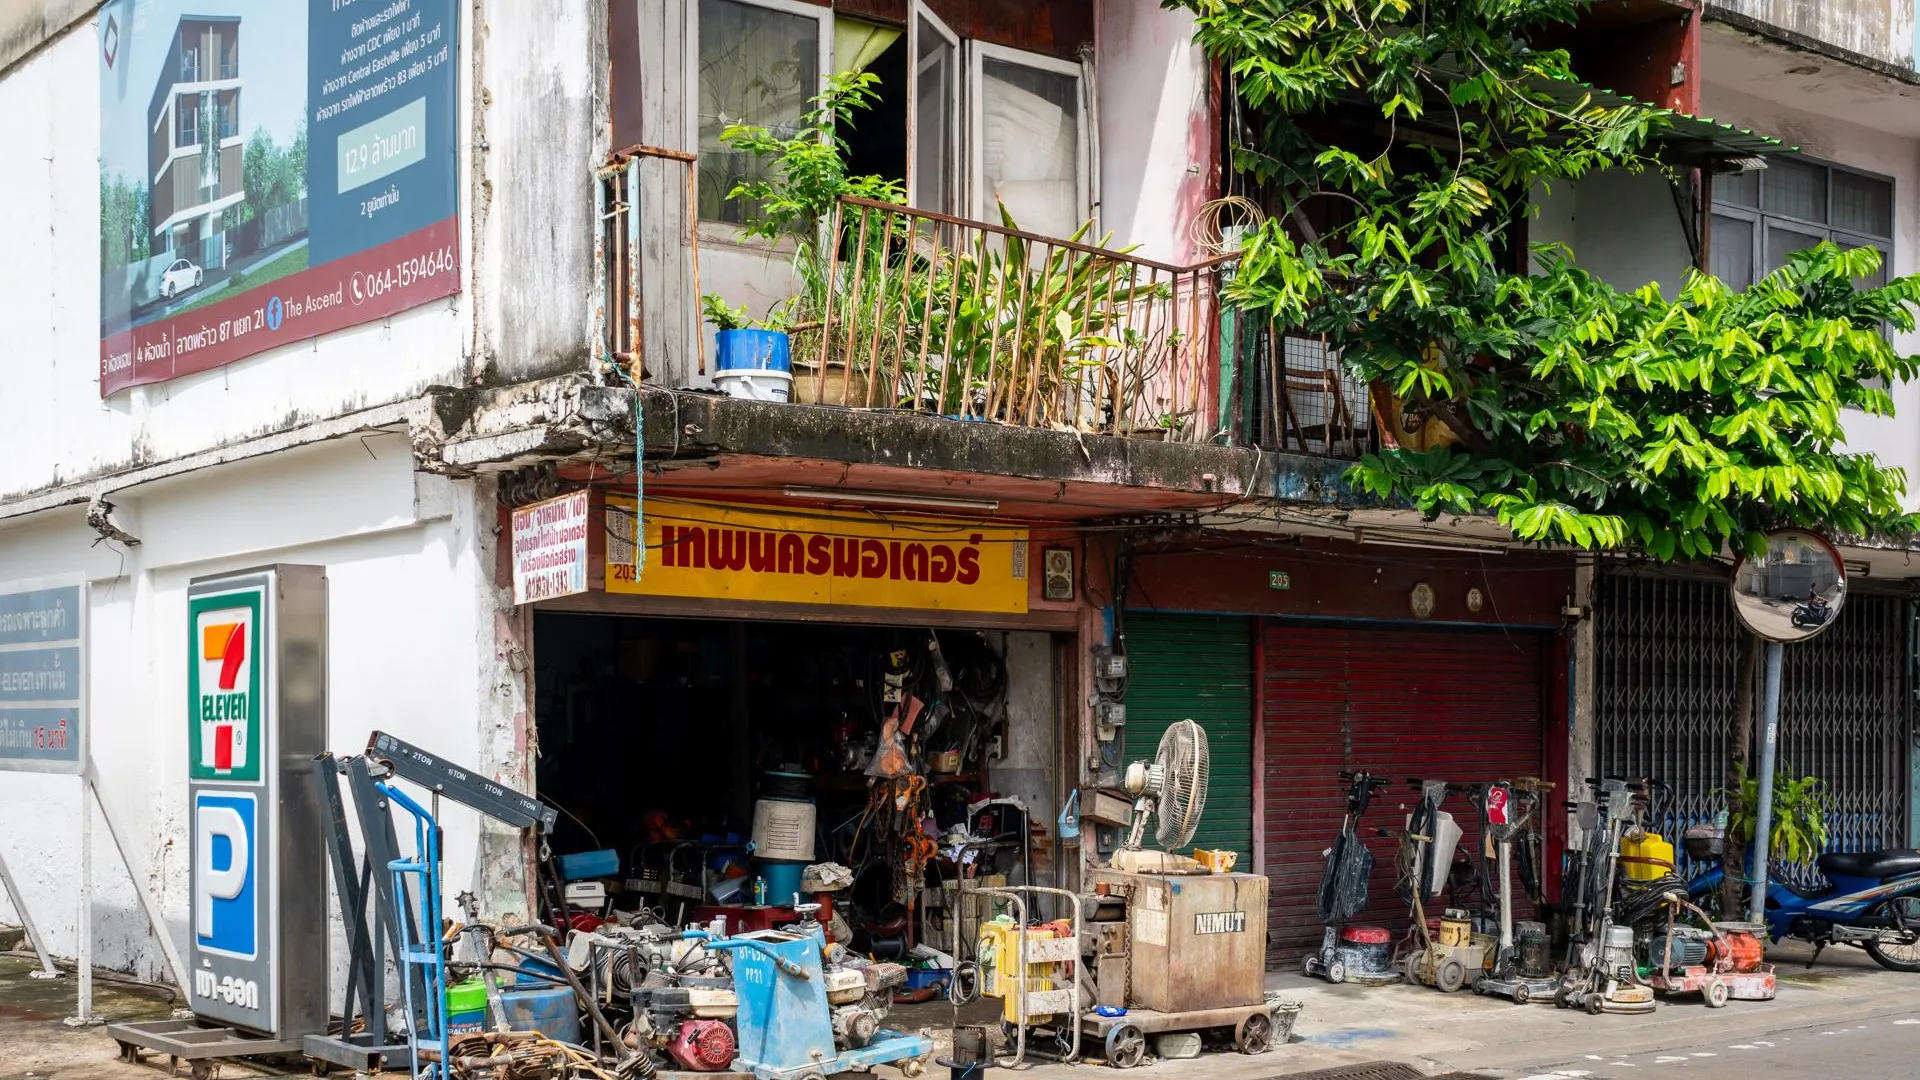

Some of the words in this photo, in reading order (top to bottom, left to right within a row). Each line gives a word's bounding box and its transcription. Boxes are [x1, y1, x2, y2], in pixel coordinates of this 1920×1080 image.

[367, 34, 382, 52] CDC
[407, 11, 420, 32] นาที
[348, 63, 371, 84] Central
[372, 50, 400, 73] Eastville
[420, 33, 426, 48] 5
[427, 22, 441, 44] นาที
[397, 69, 407, 85] 83
[427, 55, 433, 70] 5
[434, 44, 448, 66] นาที
[345, 144, 368, 175] 12.9
[372, 125, 416, 164] ล้านบาท
[361, 202, 366, 215] 2
[366, 245, 453, 298] 064-1594646
[285, 297, 302, 319] The
[305, 281, 343, 314] Ascend
[102, 359, 108, 375] 3
[137, 347, 143, 362] 4
[144, 332, 171, 362] ห้องน้ำ
[176, 325, 217, 354] ลาดพร้าว
[220, 321, 231, 341] 87
[234, 315, 251, 337] แยก
[254, 308, 264, 330] 21
[614, 564, 637, 582] 203
[662, 524, 983, 585] เทพนครมอเตอร์
[1271, 574, 1288, 587] 205
[33, 725, 45, 750] 15
[46, 718, 67, 750] นาที
[484, 783, 504, 797] 1TON
[198, 806, 248, 939] P
[1195, 912, 1245, 935] NIMUT
